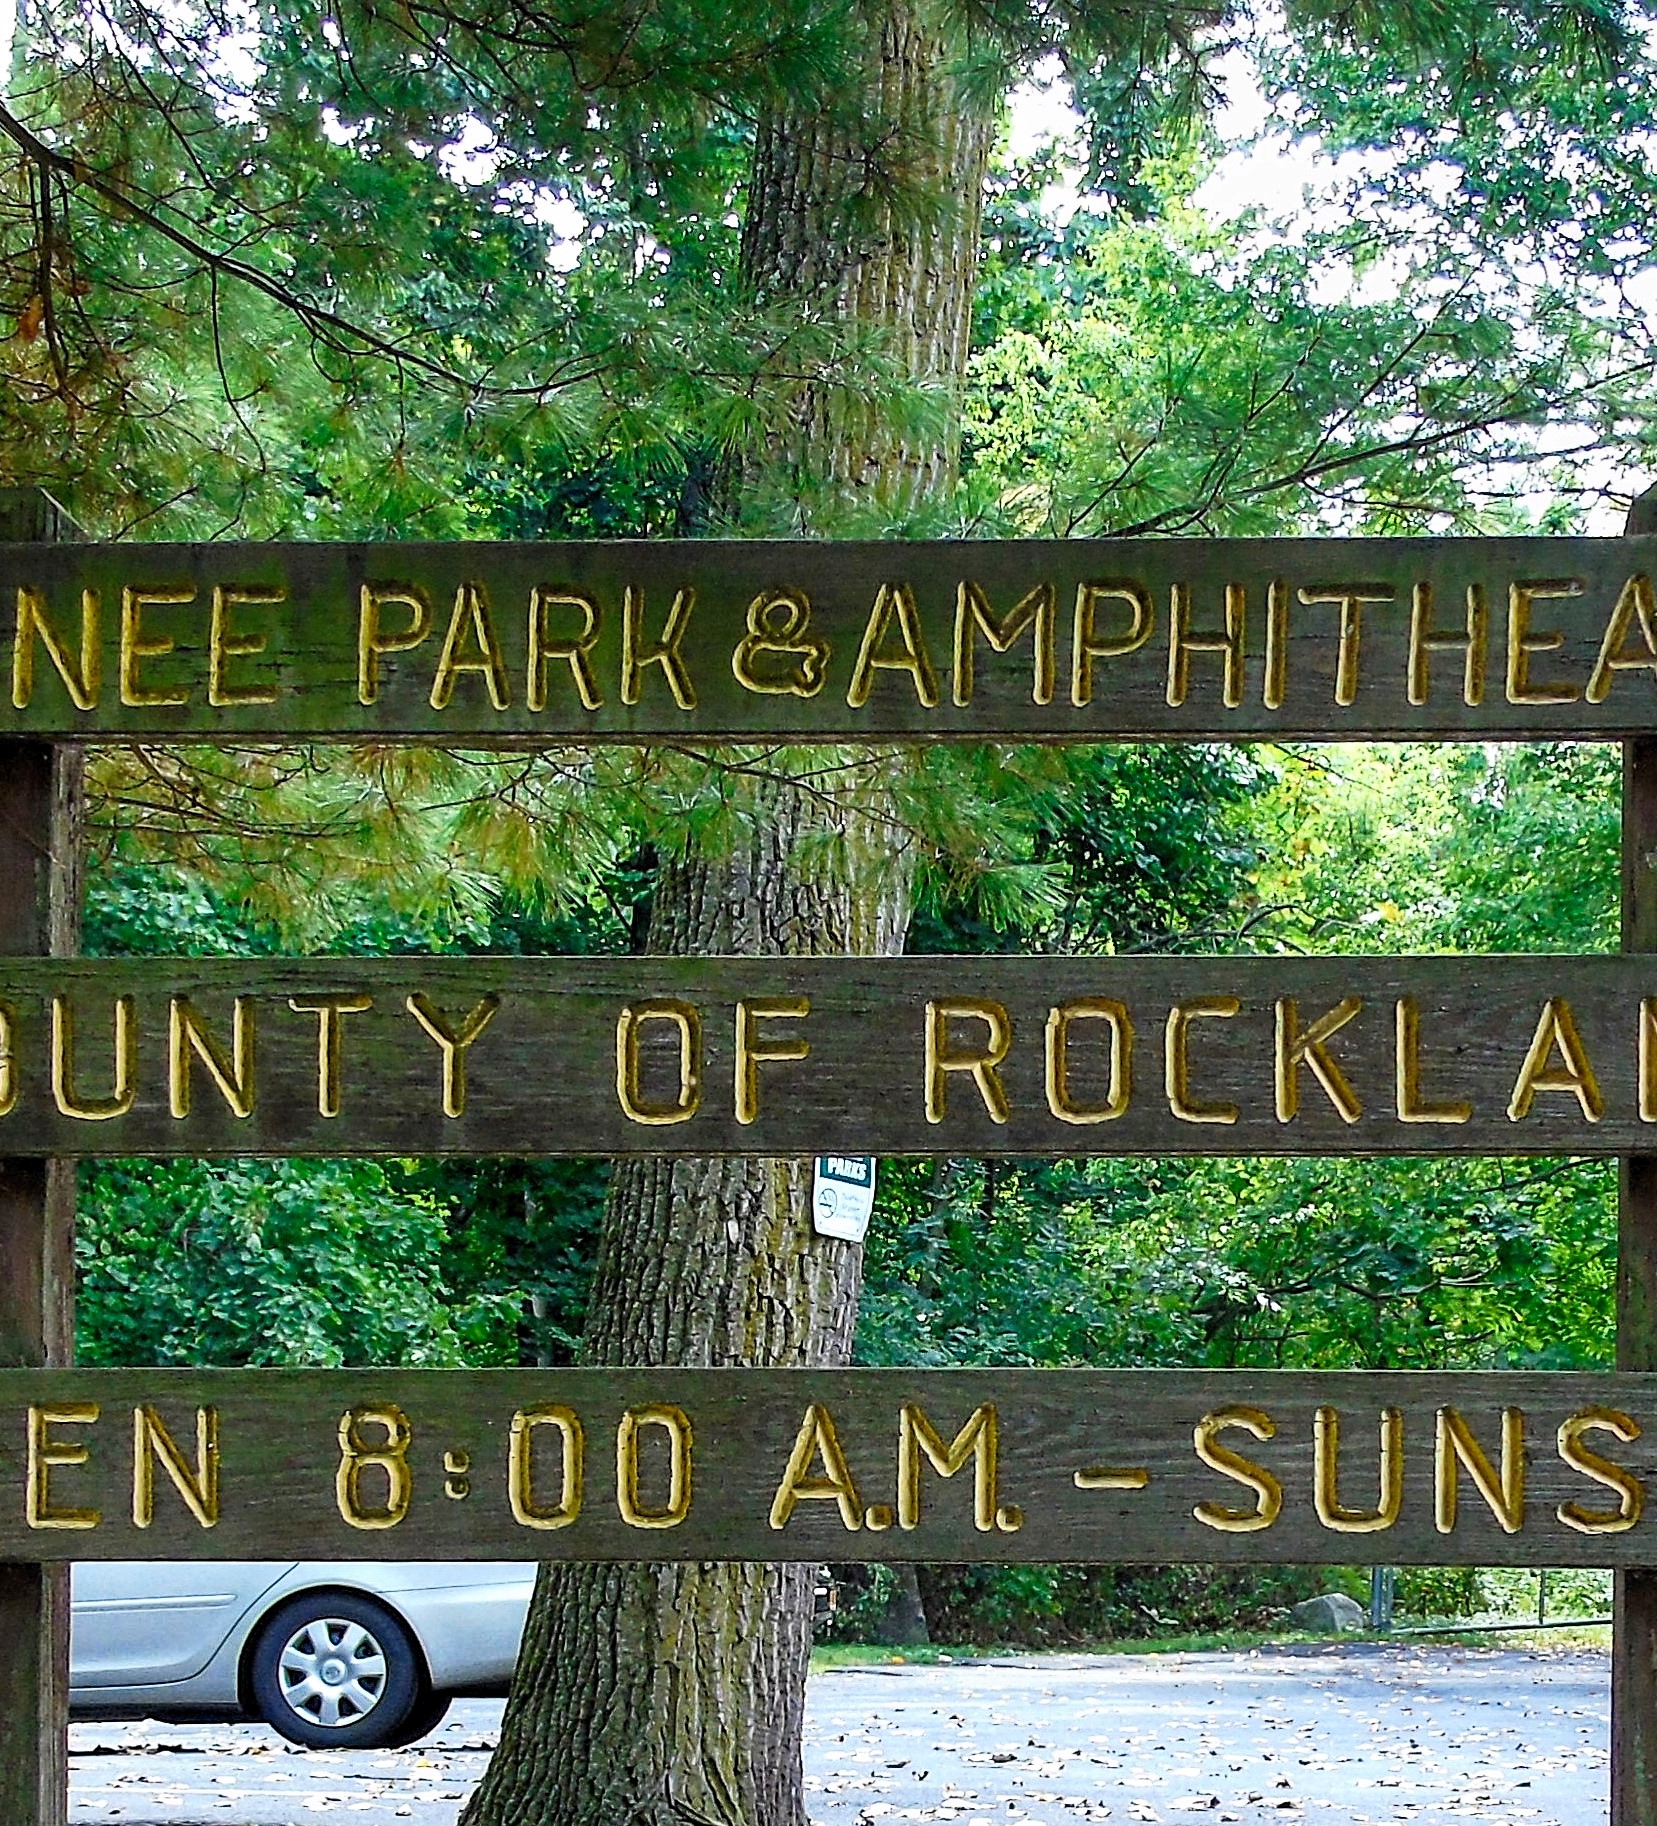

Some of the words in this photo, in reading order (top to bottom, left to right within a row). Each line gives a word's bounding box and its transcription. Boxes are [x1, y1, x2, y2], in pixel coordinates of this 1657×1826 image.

[358, 580, 700, 712] PARK
[732, 584, 828, 698] &
[615, 995, 812, 1126] OF
[827, 1157, 867, 1181] PARKS
[335, 1402, 694, 1531] 8:00
[768, 1402, 1020, 1533] A.M.
